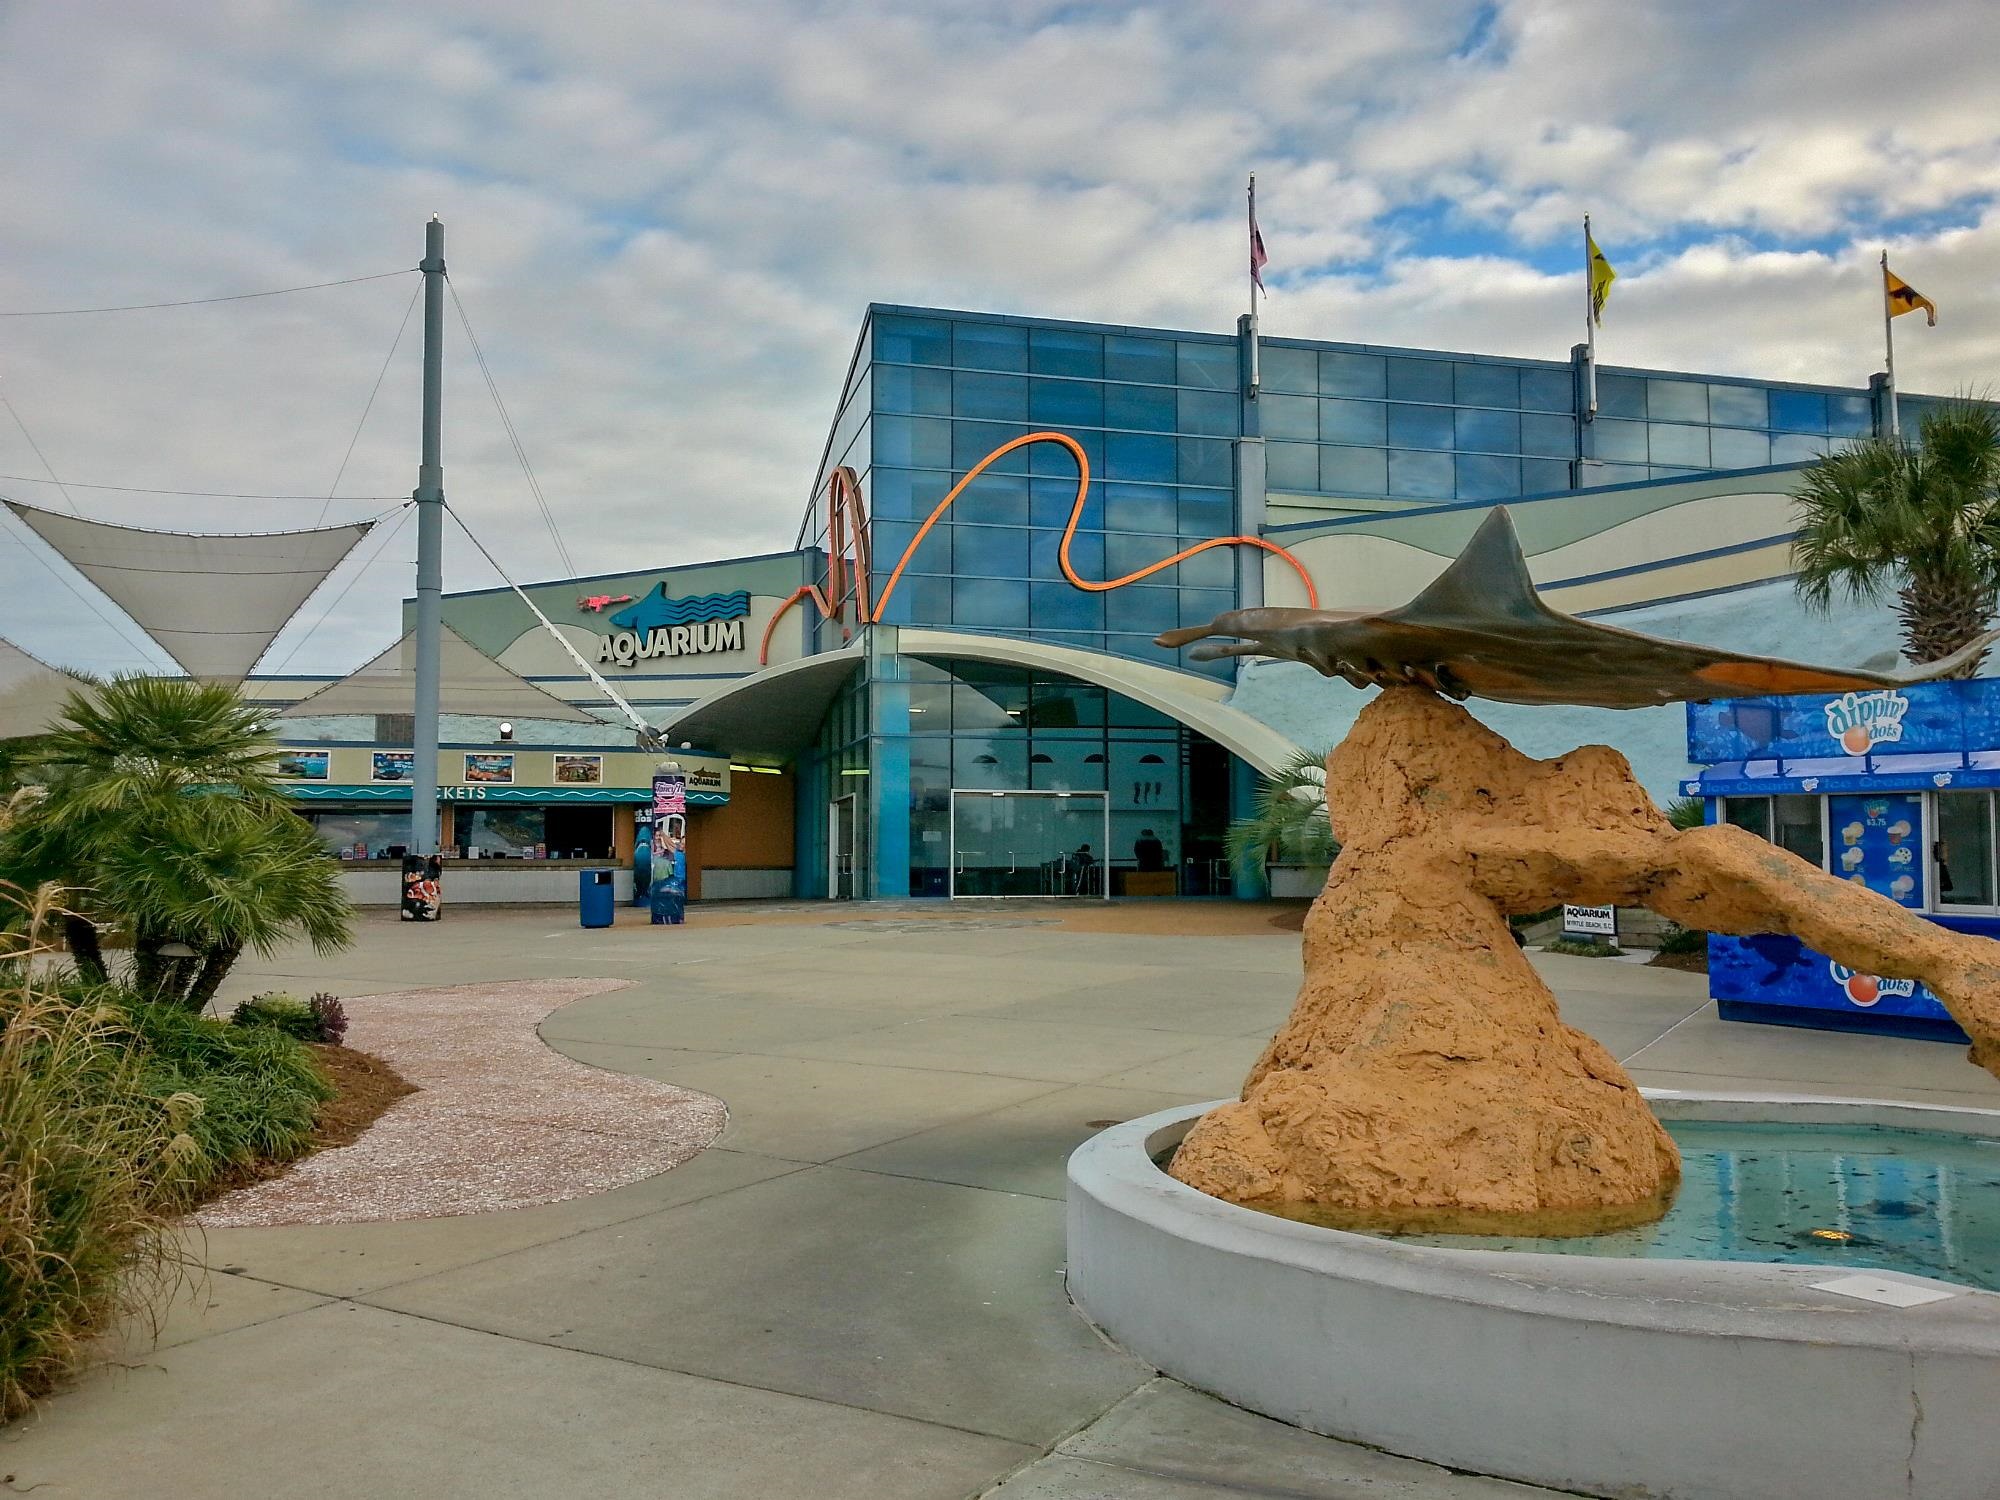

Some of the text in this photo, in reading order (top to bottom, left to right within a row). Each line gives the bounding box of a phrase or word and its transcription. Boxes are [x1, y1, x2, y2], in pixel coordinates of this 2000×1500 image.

[598, 621, 743, 667] AQUARIUM
[1869, 723, 1899, 739] dots
[689, 777, 721, 786] AQUARIUM
[1567, 908, 1610, 919] AQUARIUM
